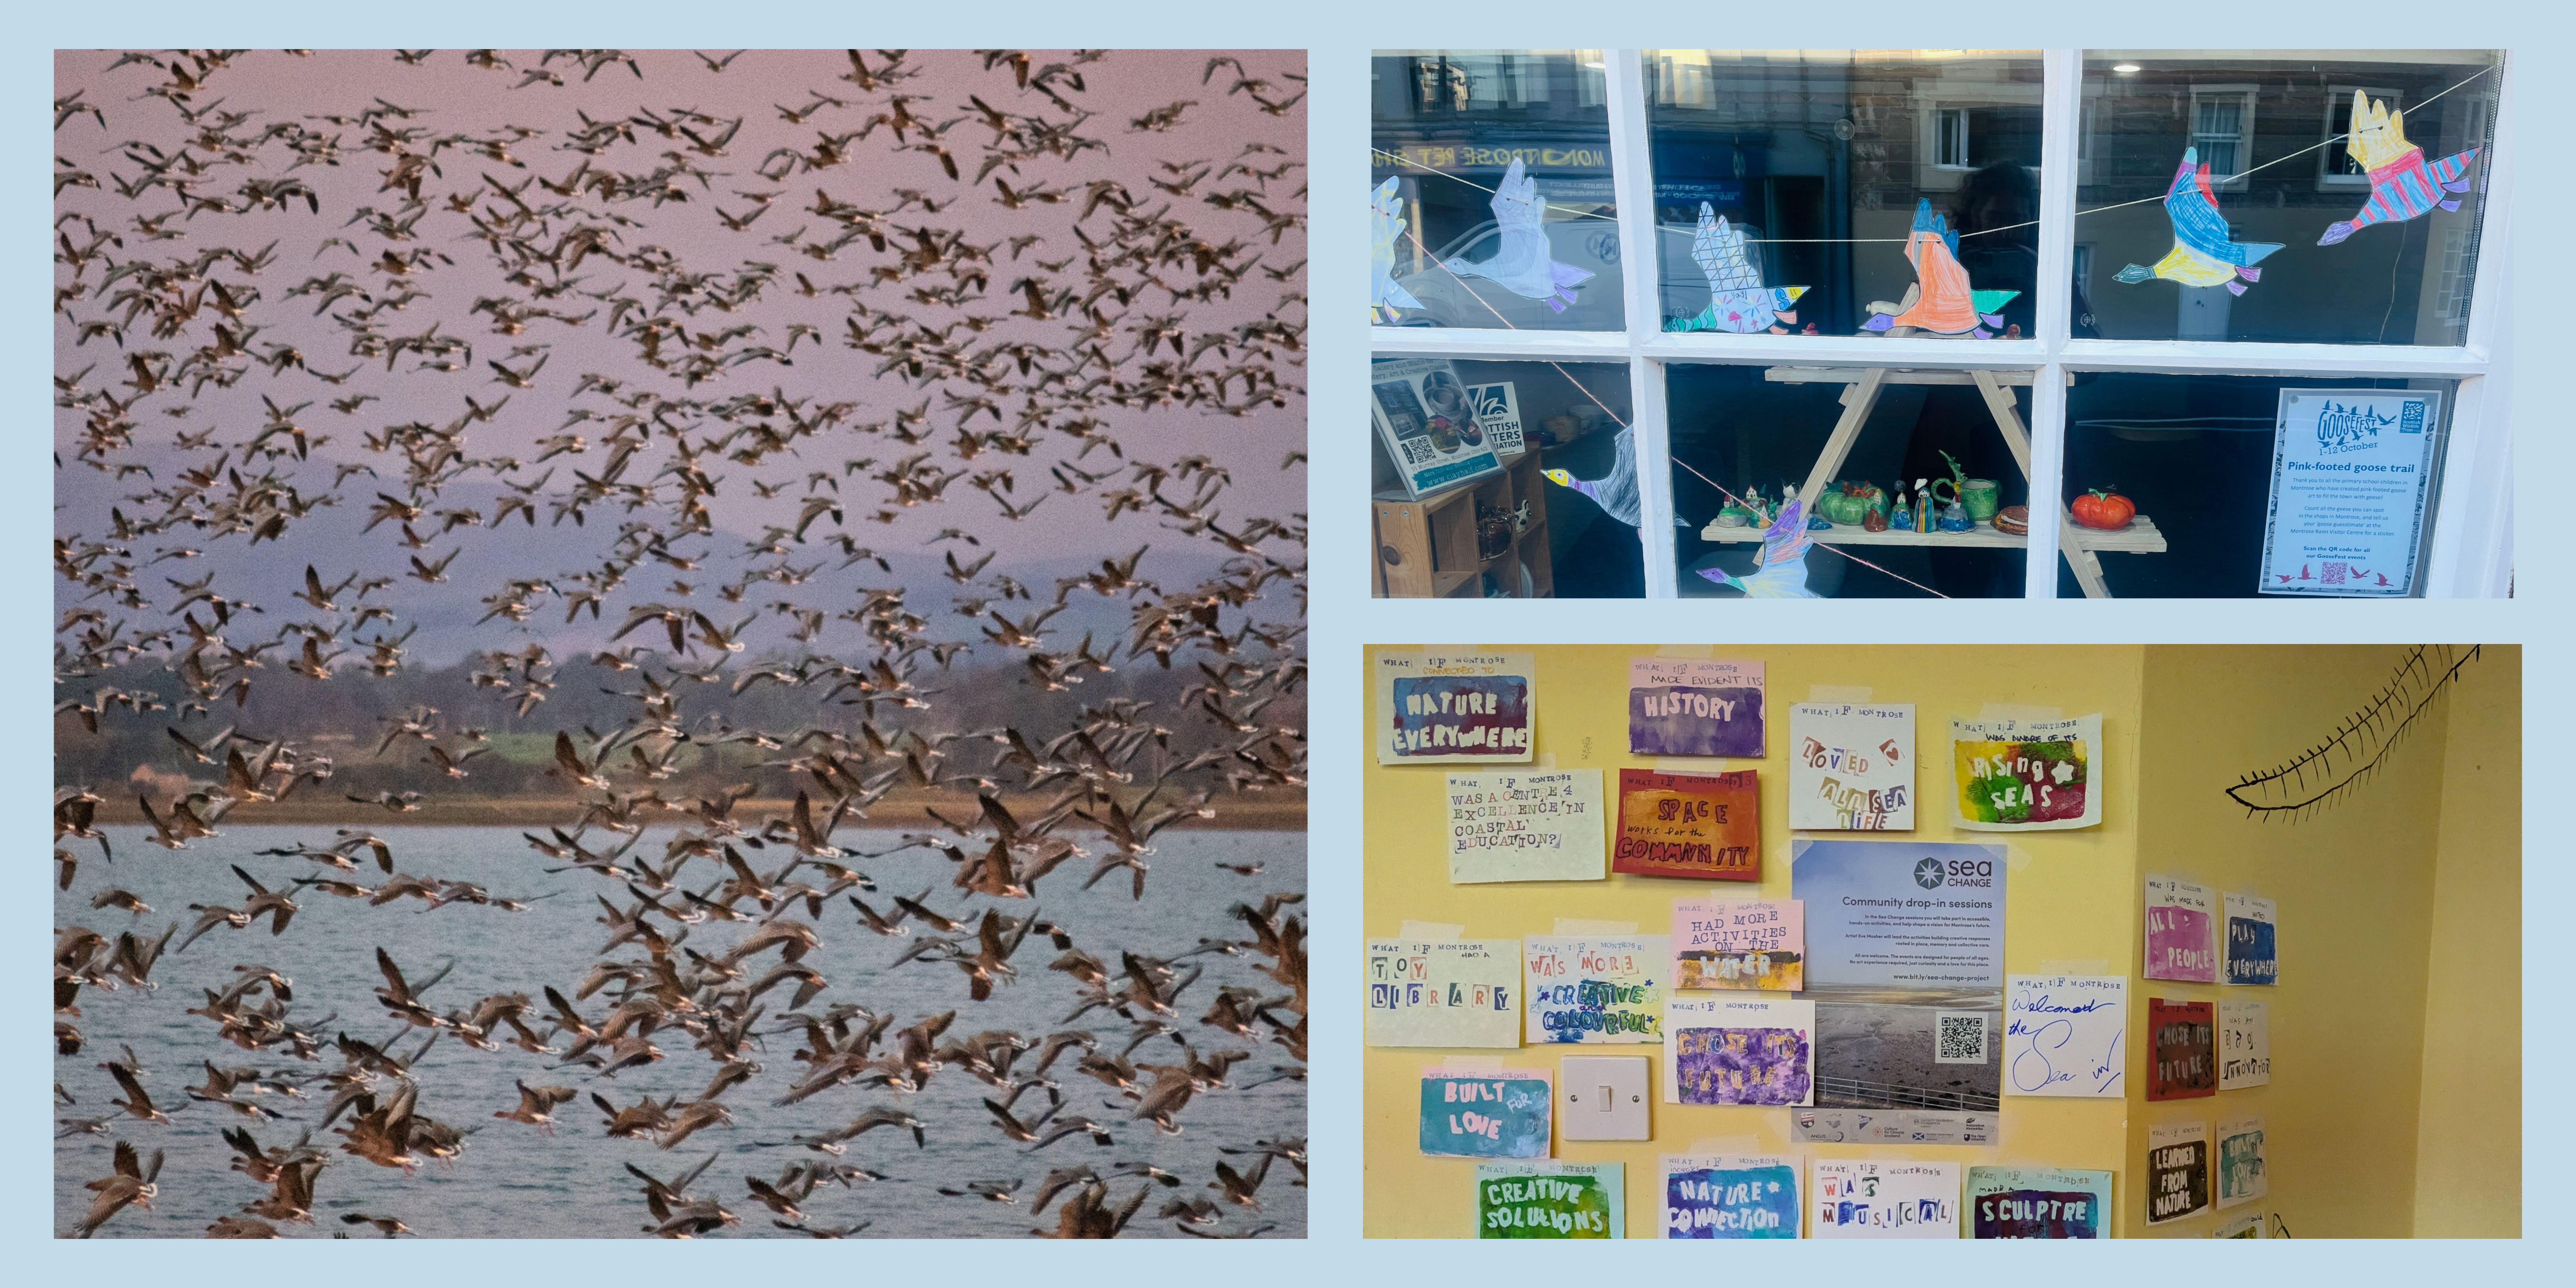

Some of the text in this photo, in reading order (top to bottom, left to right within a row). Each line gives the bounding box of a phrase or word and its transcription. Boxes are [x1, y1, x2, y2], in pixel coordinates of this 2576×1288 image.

[1402, 446, 1412, 462] SCAN
[2319, 442, 2378, 455] 1-12 October
[2288, 462, 2414, 473] Pink-footed goose trail
[1692, 676, 1741, 684] EVIDENT
[1747, 677, 1762, 686] ITS
[1407, 691, 1497, 716] NATURE
[1644, 692, 1735, 722] HISTORY
[1802, 743, 1869, 773] LOVED
[1451, 785, 1572, 805] WAS A CENTRE 4
[1823, 785, 1906, 811] ALL SEA
[1991, 784, 2053, 810] SEAS
[1566, 803, 1585, 814] IN
[1658, 799, 1728, 824] SPACE
[1455, 820, 1525, 836] COASTAL
[1665, 828, 1686, 836] for
[1689, 827, 1706, 837] the
[1948, 860, 1992, 877] sea
[1948, 878, 1991, 887] CHANGE
[1843, 897, 1992, 910] Community drop-in sessions
[2165, 894, 2175, 903] WAS
[1691, 911, 1778, 931] HAD MORE
[2150, 910, 2175, 935] ALL
[1691, 927, 1786, 944] ACTIVITIES
[1715, 940, 1778, 952] ON THE
[1376, 958, 1423, 978] TOY
[1531, 956, 1633, 976] WAS MORE
[1700, 954, 1771, 979] WATER
[2168, 947, 2209, 970] PEOPLE
[2226, 958, 2277, 978] EVERYWHERE
[1552, 983, 1645, 1005] CREATIVE
[2017, 980, 2043, 989] WHAT
[2071, 981, 2120, 989] MONTROSE
[1376, 988, 1508, 1008] LIBRARY
[1579, 1003, 1607, 1011] and
[1543, 1009, 1649, 1035] COLOURFUL
[2009, 1019, 2041, 1036] the
[1678, 1032, 1796, 1057] CHOSE ITS
[2156, 1026, 2209, 1046] CHOSE ITS
[2013, 1020, 2076, 1091] Sea
[1685, 1065, 1777, 1090] FUTURE
[2159, 1055, 2202, 1081] FUTURE
[1445, 1082, 1505, 1103] BUILT
[1449, 1111, 1503, 1140] LOVE
[2156, 1146, 2194, 1169] LEARNED
[1824, 1180, 1876, 1197] WAS
[2162, 1170, 2187, 1192] FROM
[1488, 1179, 1584, 1205] CREATIVE
[1680, 1180, 1762, 1205] NATURE
[1982, 1200, 2086, 1221] SCULPTRE
[2156, 1191, 2191, 1215] NATURE
[2251, 1213, 2263, 1222] could
